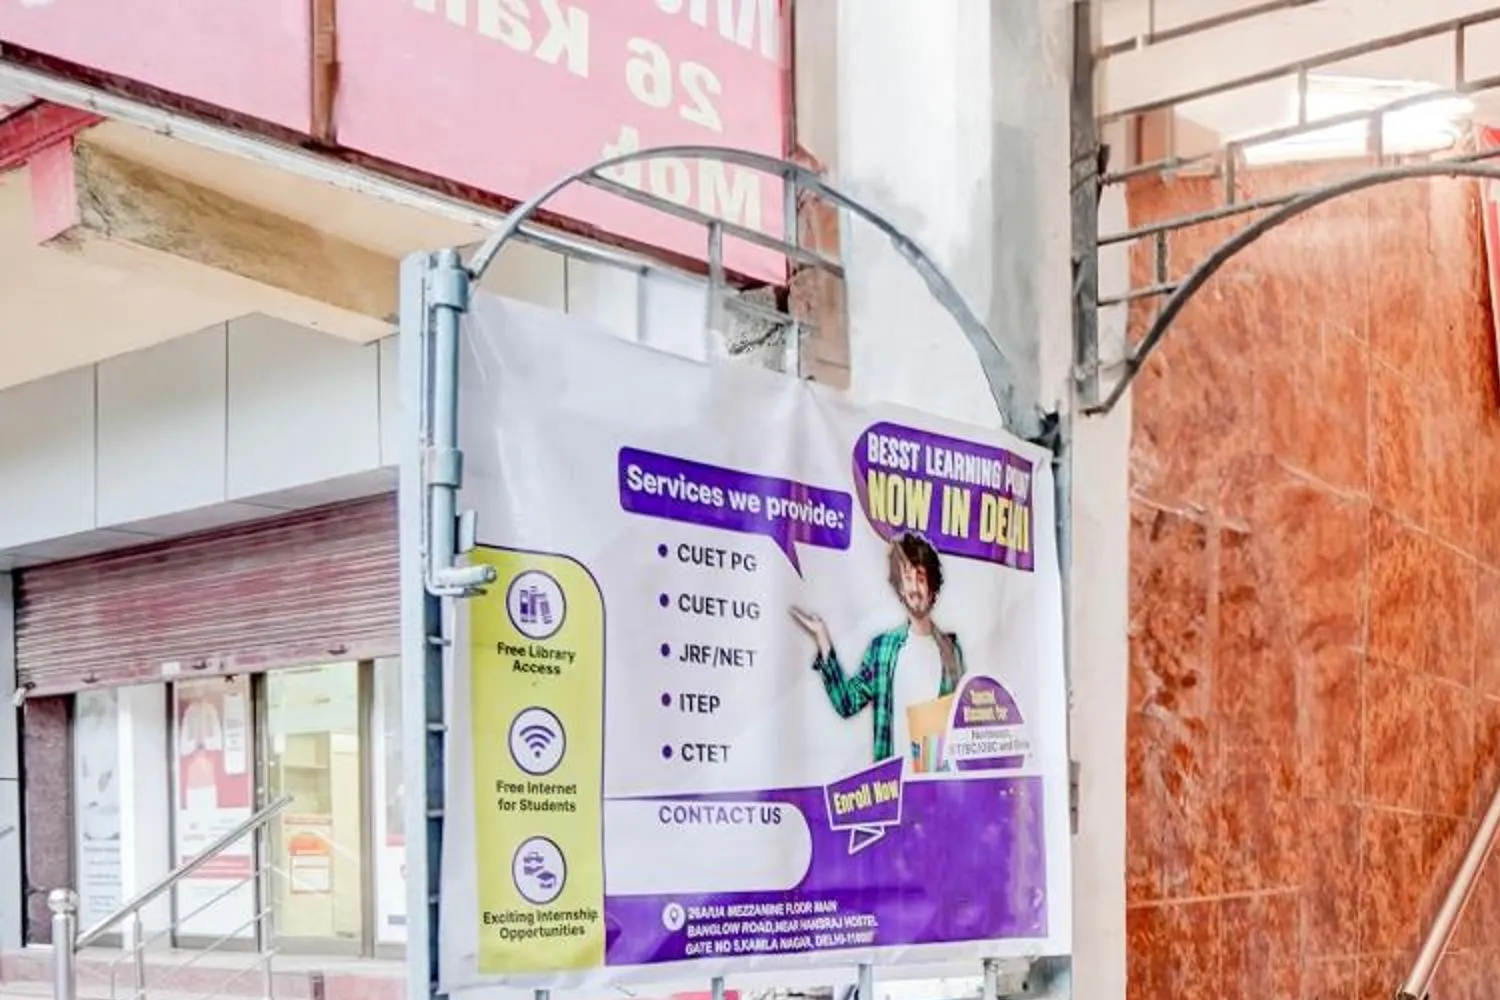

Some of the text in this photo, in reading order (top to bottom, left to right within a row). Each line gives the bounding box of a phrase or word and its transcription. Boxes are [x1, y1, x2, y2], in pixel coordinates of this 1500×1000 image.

[867, 432, 921, 473] BESST
[925, 444, 1002, 490] LEARNING
[626, 464, 844, 530] Services we provide:
[867, 468, 1029, 552] NOW IN DELHI
[677, 543, 758, 572] CUET PG
[678, 593, 761, 620] CUET UG
[497, 641, 576, 665] Free Library
[679, 644, 757, 668] JRF/NET
[512, 659, 561, 676] Access
[679, 693, 721, 714] ITEP
[681, 743, 731, 763] CTET
[496, 780, 577, 796] Free Internet
[834, 778, 899, 815] Enroll Now
[498, 798, 576, 813] for Students
[659, 805, 782, 825] CONTACT US
[483, 907, 598, 926] Exciting Internship
[500, 924, 585, 943] Opportunities
[687, 921, 740, 939] BANGLOW
[685, 941, 713, 956] GATE
